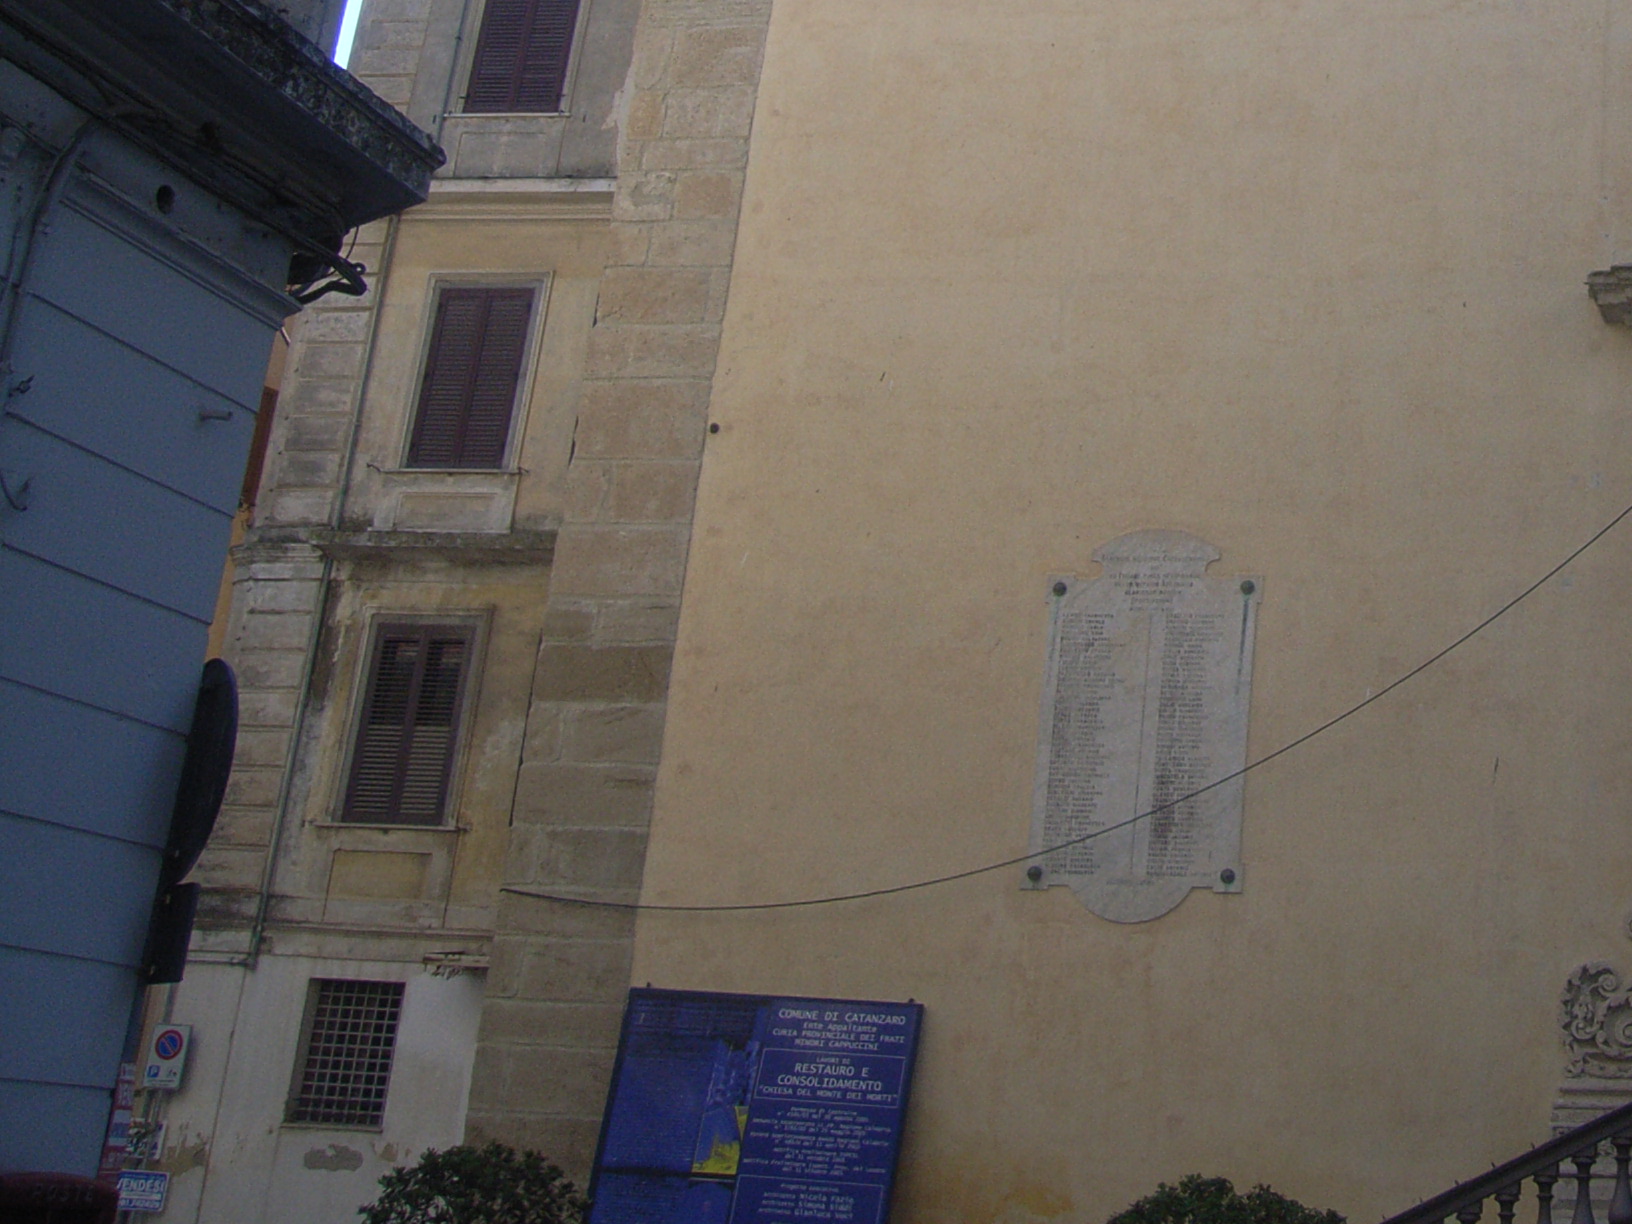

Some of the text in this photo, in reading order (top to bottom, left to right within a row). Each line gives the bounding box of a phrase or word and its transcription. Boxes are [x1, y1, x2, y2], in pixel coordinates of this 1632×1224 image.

[778, 1008, 906, 1025] COMUNE DI CATANZARO
[803, 1021, 877, 1033] Ente Appaltante
[772, 1028, 905, 1044] CURIA PROVINCIALE DEI FRATI
[794, 1039, 879, 1051] MINORI CAPPUCCINI
[794, 1062, 870, 1078] RESTAURO E
[777, 1074, 882, 1092] CONSOLIDAMENTO
[797, 1088, 812, 1097] DEL
[816, 1090, 843, 1099] MONTE
[846, 1091, 862, 1100] DEI
